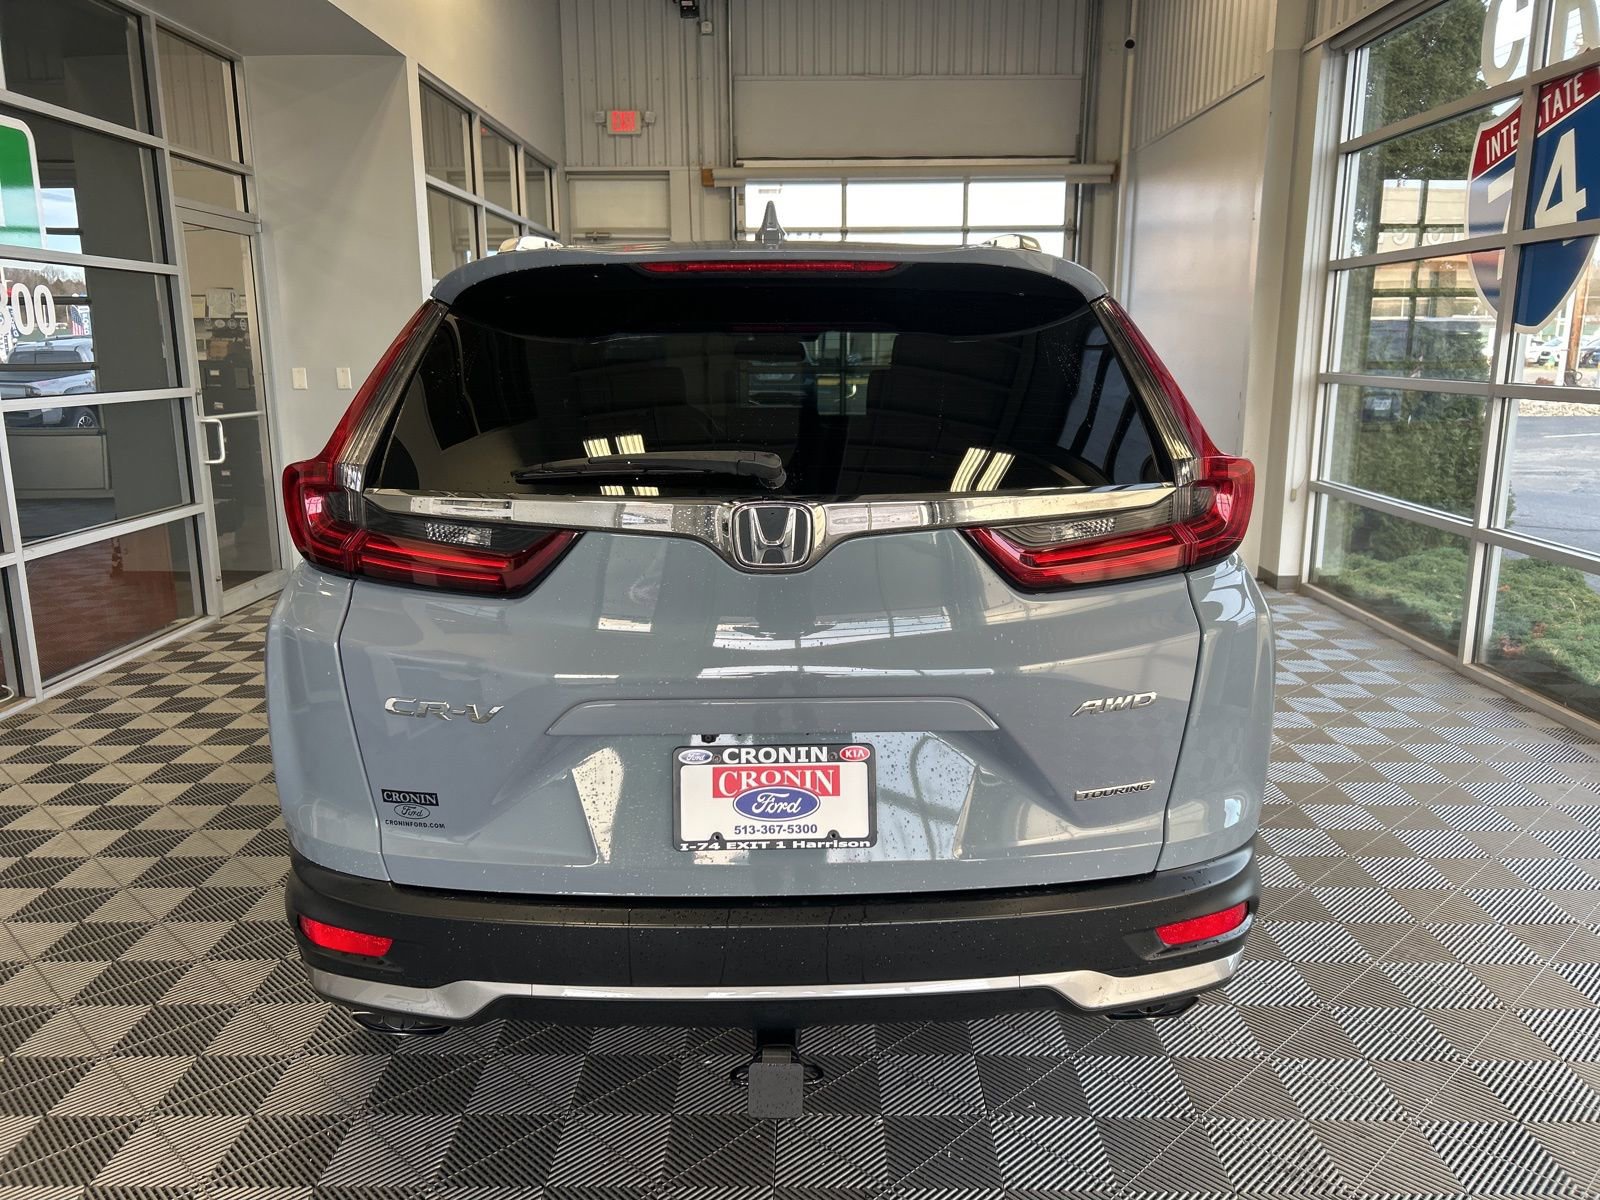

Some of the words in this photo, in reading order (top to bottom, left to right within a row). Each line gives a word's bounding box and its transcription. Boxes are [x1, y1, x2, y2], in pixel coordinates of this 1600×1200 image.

[385, 697, 505, 724] CR-V
[1071, 692, 1157, 717] AWD
[722, 746, 828, 764] CRONIN
[845, 749, 865, 759] KIA
[718, 769, 835, 796] CRONIN
[383, 791, 437, 804] CRONIN
[1083, 783, 1150, 799] TOURING
[751, 792, 803, 814] Ford
[401, 805, 424, 817] Ford
[385, 819, 446, 829] CRONINFORD.COM
[734, 824, 818, 835] 513-367-5300
[680, 842, 720, 851] I-74
[726, 841, 770, 850] EXIT
[775, 841, 787, 849] 1
[792, 839, 871, 849] Harrison
